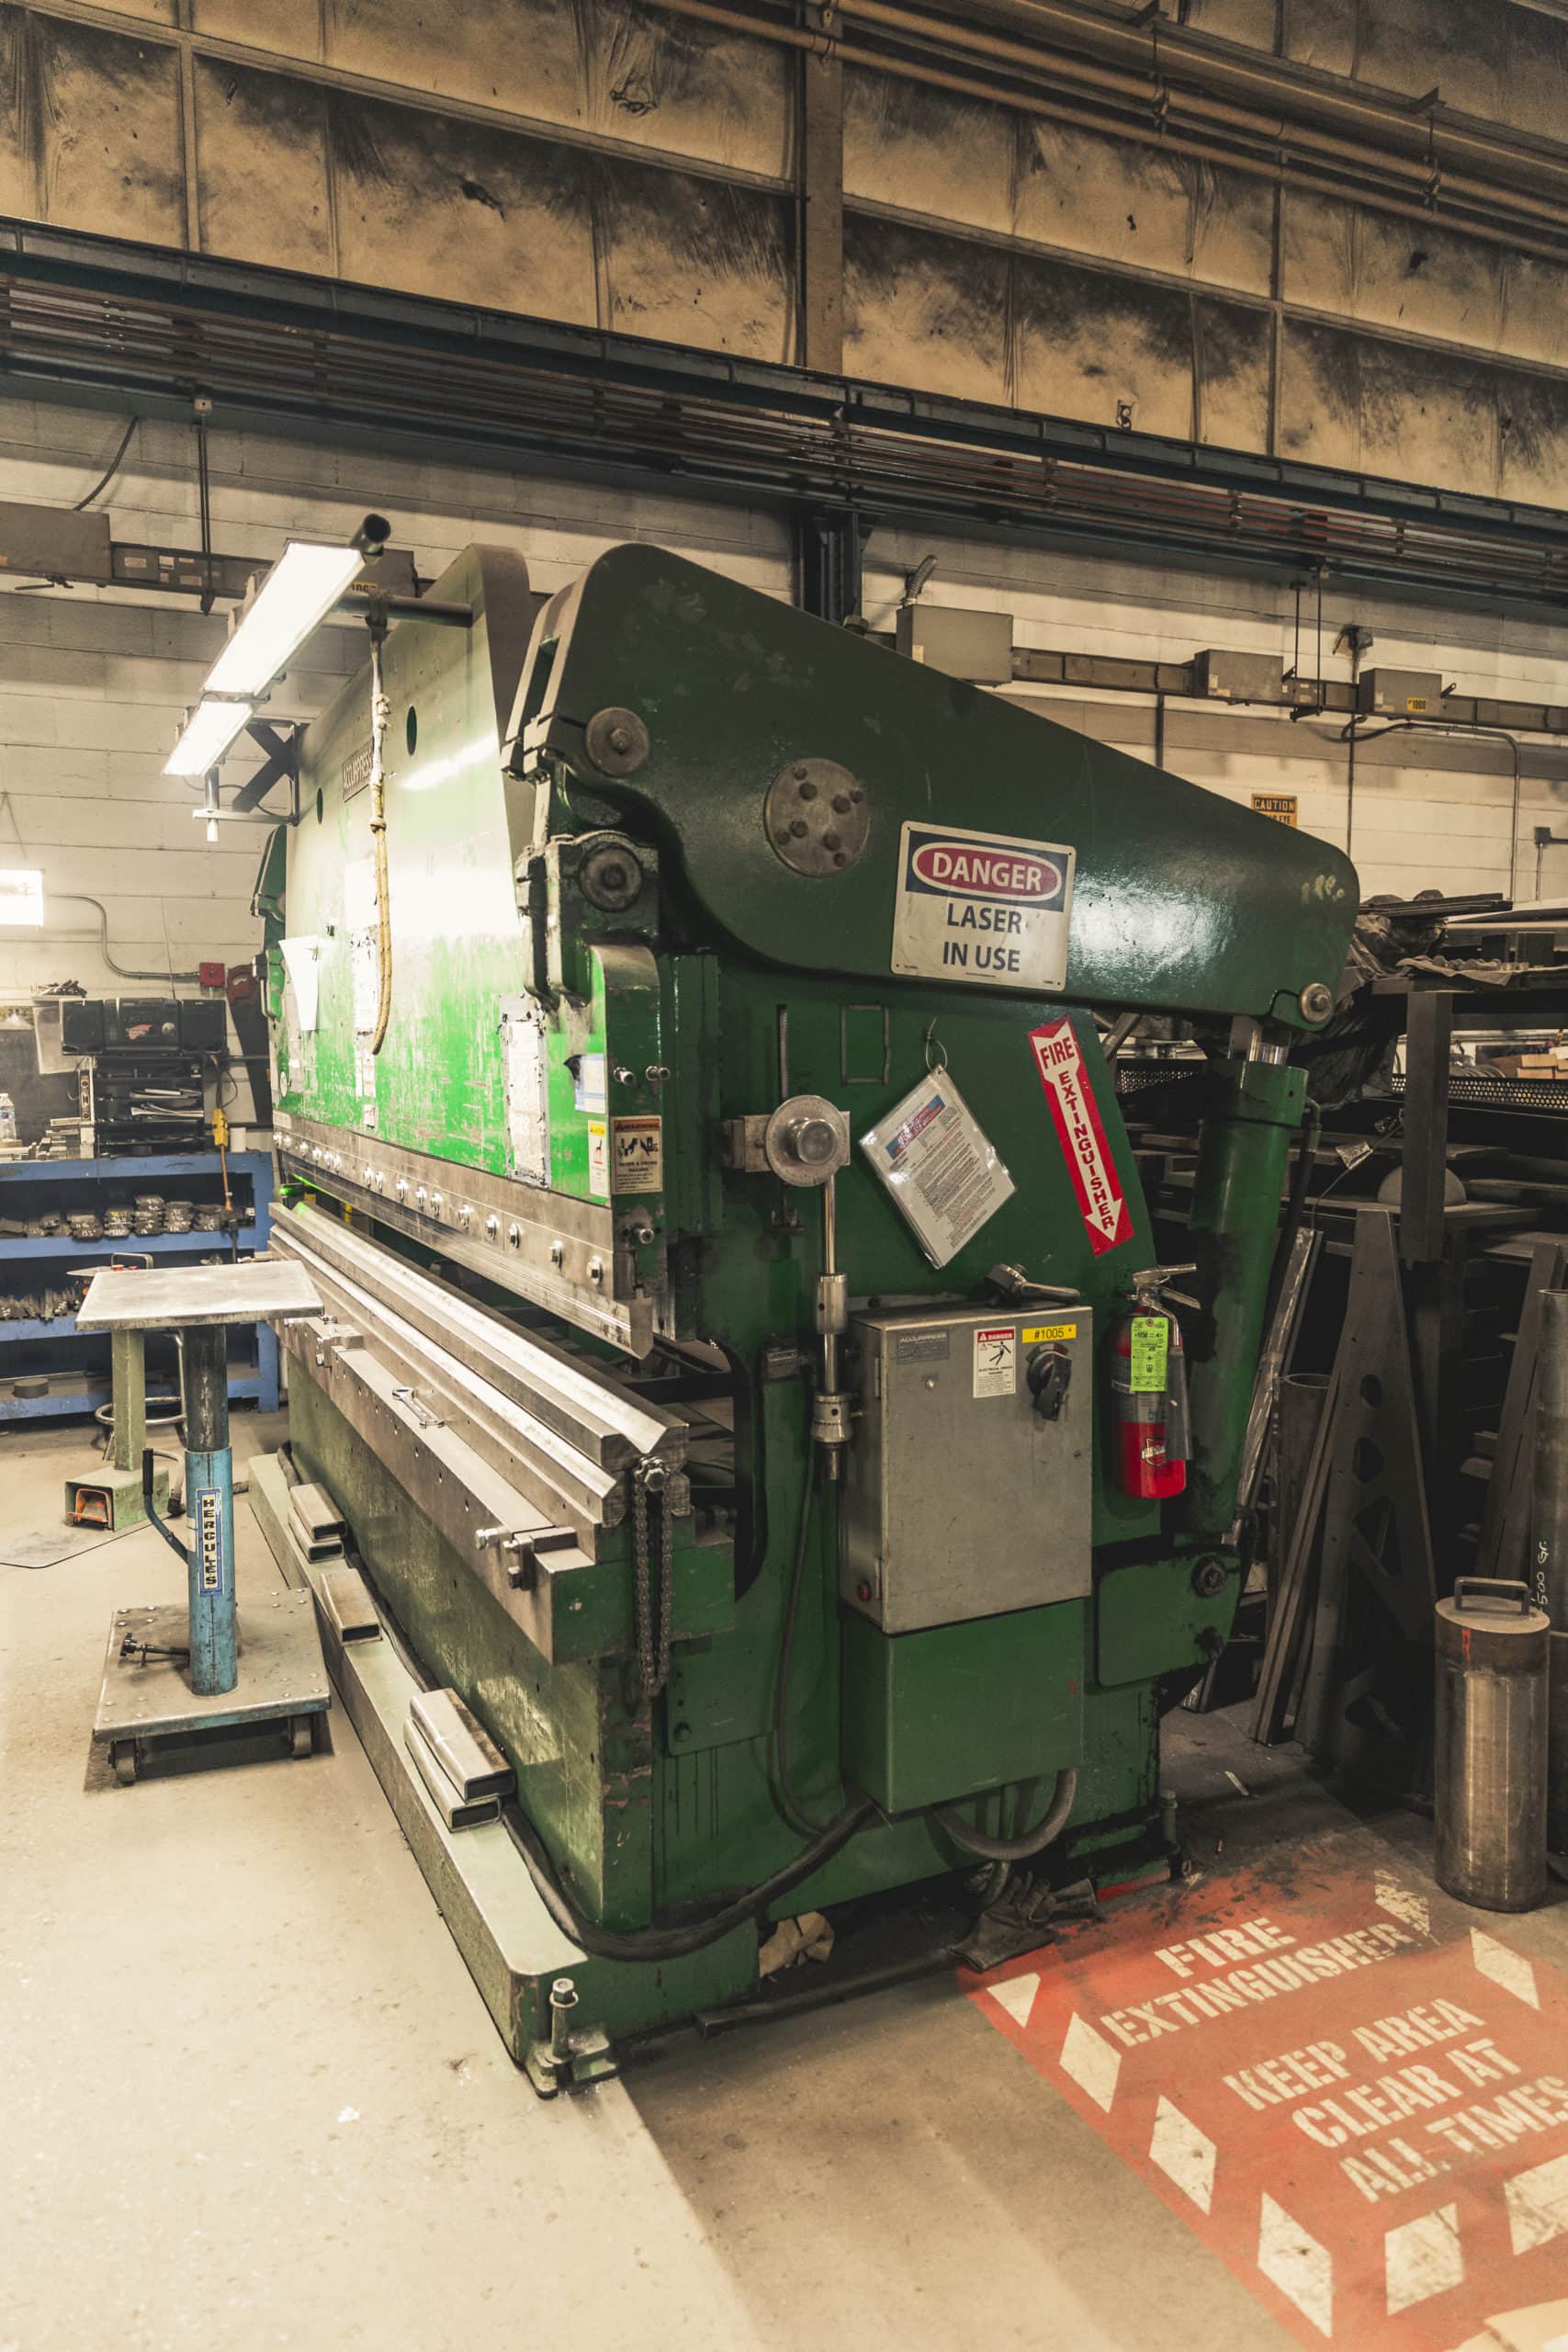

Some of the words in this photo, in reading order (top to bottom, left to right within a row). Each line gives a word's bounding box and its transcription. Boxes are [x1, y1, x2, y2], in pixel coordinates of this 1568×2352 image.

[1255, 799, 1294, 811] CAUTION
[932, 852, 1043, 892] DANGER
[947, 902, 1022, 934] LASER
[942, 941, 968, 966] IN
[976, 944, 1021, 973] USE
[1040, 1036, 1075, 1069] FIRE
[1058, 1070, 1115, 1230] EXTINGUISHER
[1034, 1328, 1065, 1339] #1005
[203, 1499, 217, 1585] HERCULES
[1154, 1917, 1297, 1978] FIRE
[1100, 1924, 1416, 2048] EXTINGUISHER
[1222, 2041, 1351, 2110] KEEP
[1352, 1998, 1488, 2063] AREA
[1292, 2064, 1464, 2147] CLEAR
[1446, 2038, 1521, 2087] AT
[1339, 2138, 1451, 2203] ALL
[1425, 2075, 1568, 2155] TIMES
